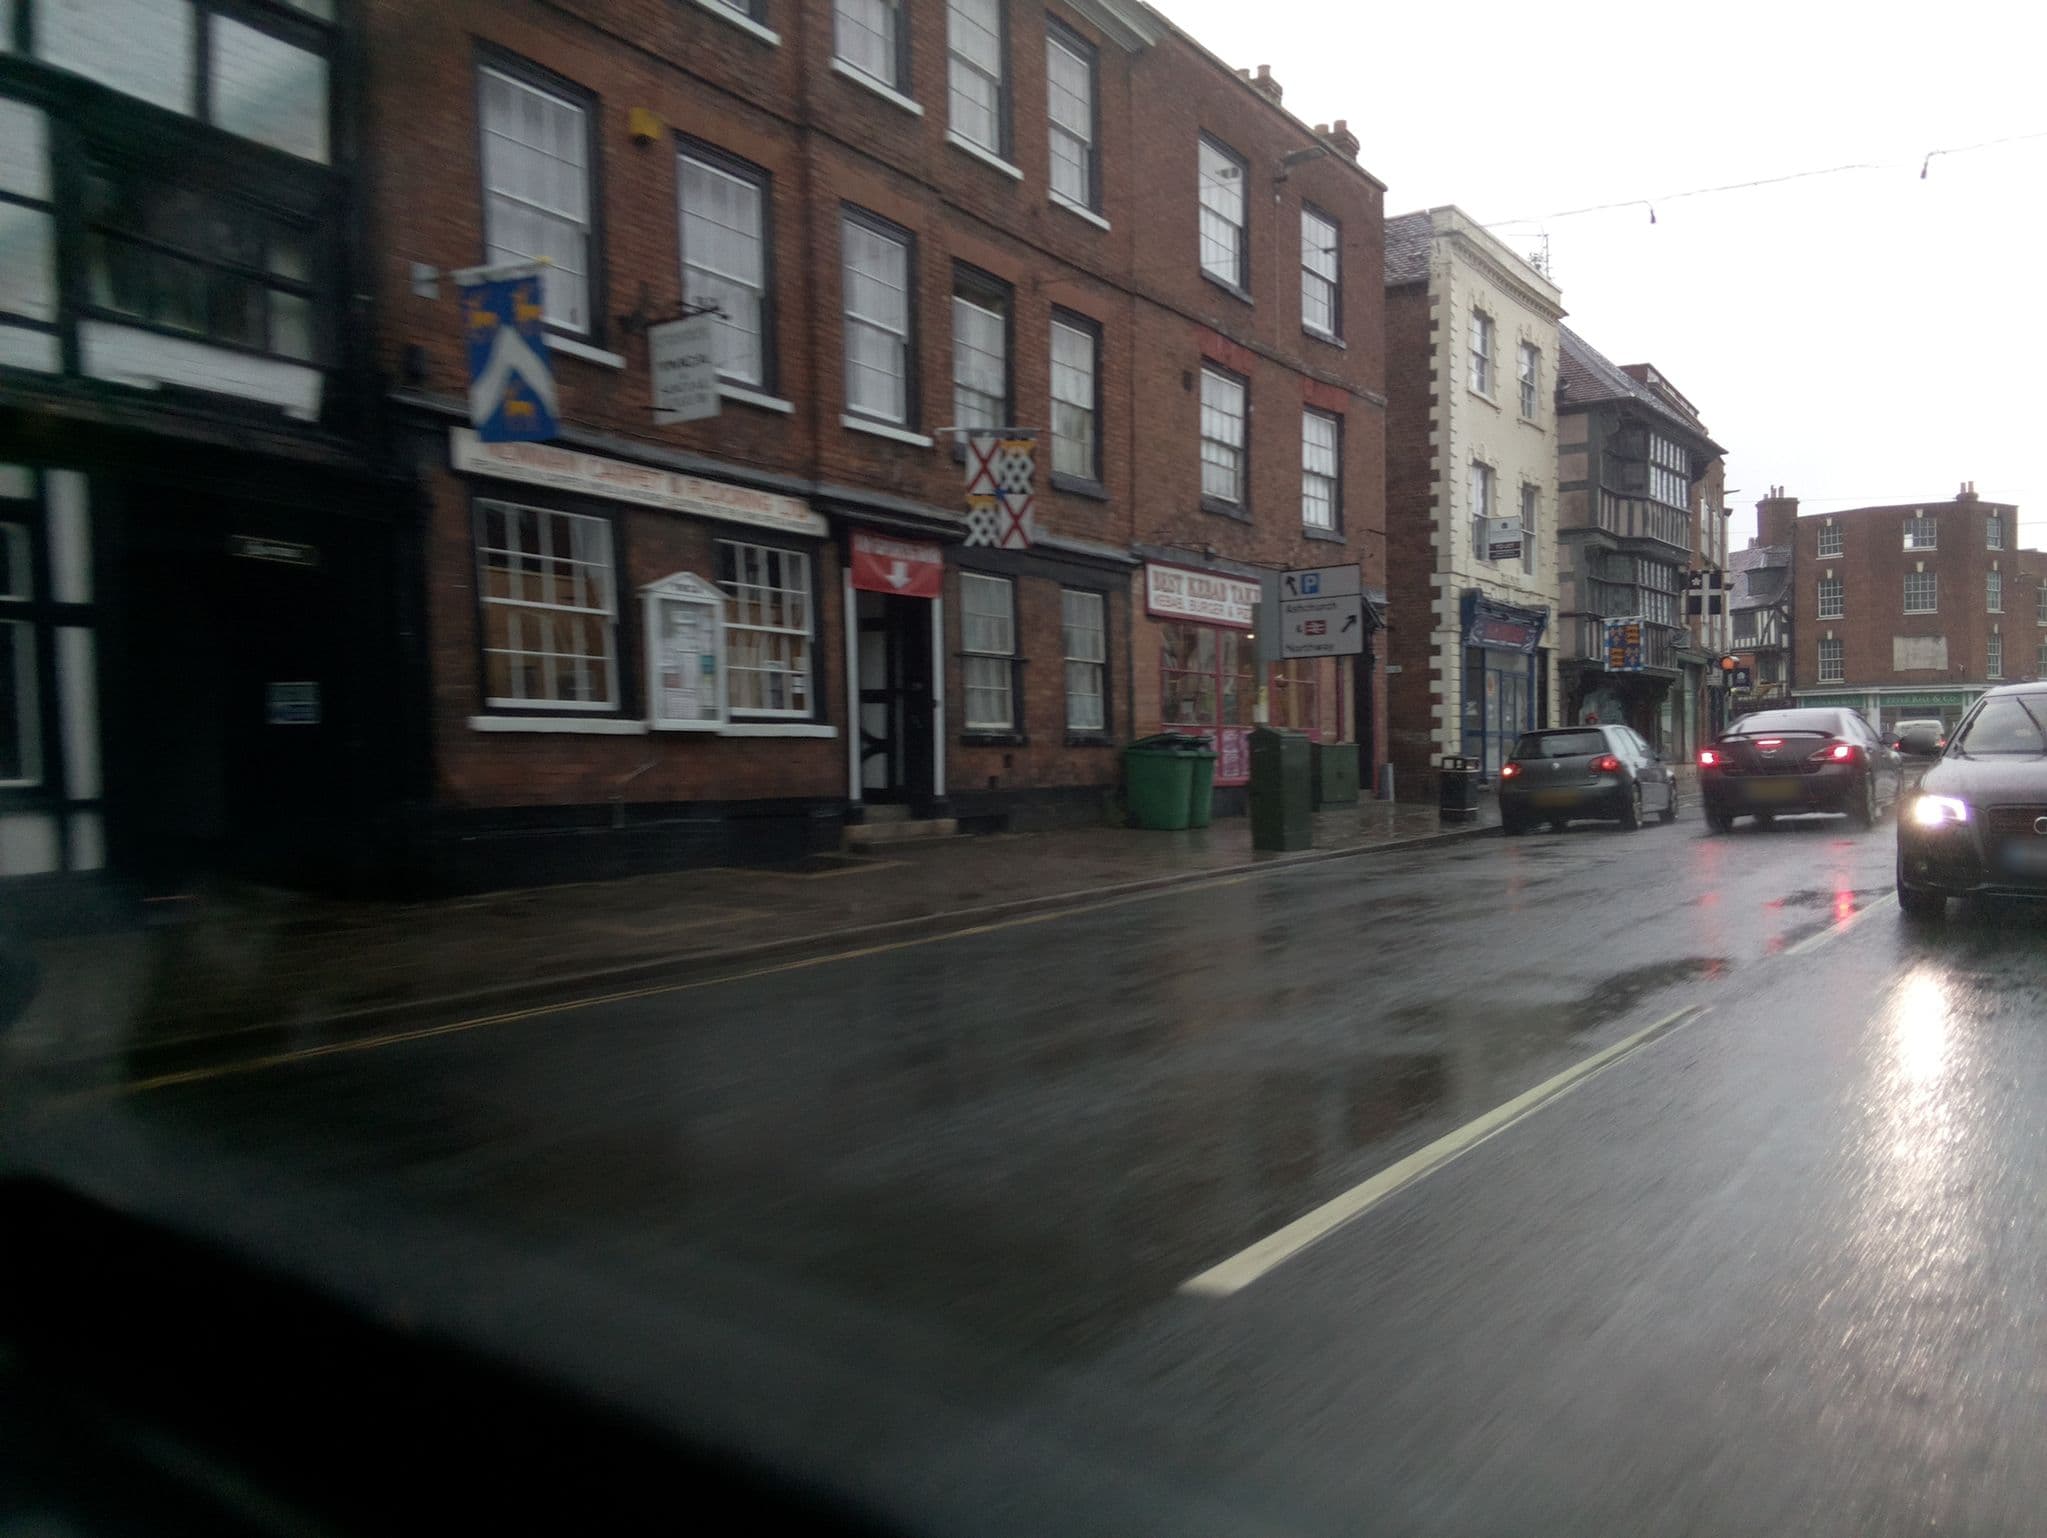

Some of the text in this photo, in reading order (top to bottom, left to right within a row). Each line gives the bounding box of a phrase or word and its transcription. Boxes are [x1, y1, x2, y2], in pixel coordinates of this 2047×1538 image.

[1151, 570, 1183, 595] BEST
[1187, 577, 1227, 602] KEBAB
[1304, 575, 1318, 593] P
